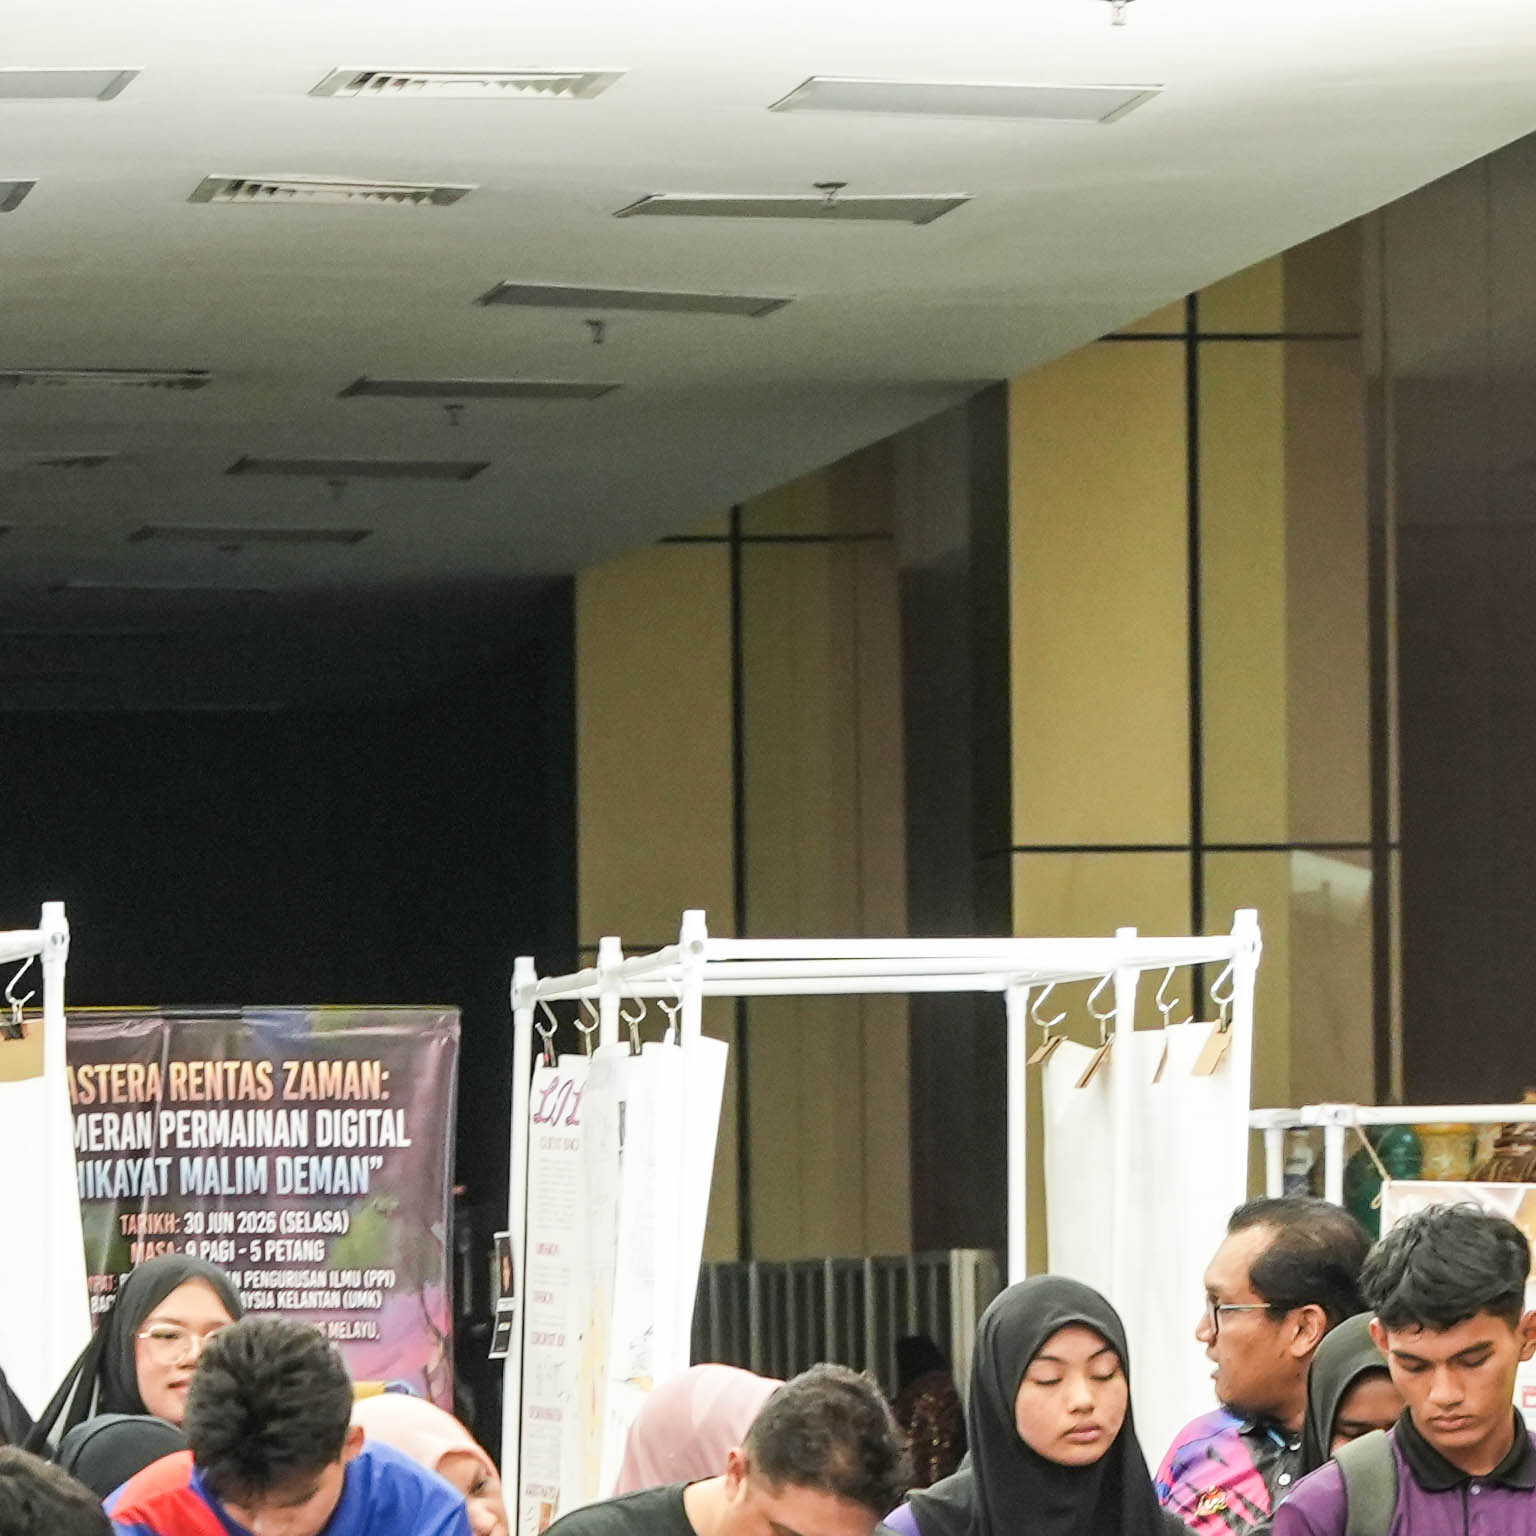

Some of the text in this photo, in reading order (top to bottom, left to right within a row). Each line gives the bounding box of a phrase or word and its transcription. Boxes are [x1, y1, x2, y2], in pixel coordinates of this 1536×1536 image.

[169, 1061, 273, 1101] RENTAS
[282, 1060, 390, 1101] ZAMAN:
[159, 1109, 308, 1149] PERMAINAN
[316, 1109, 412, 1148] DIGITAL
[180, 1156, 268, 1196] MALIM
[119, 1209, 349, 1236] TARIKH: 30 JUN 2026 (SELASA)
[199, 1240, 235, 1262] PAGI
[250, 1240, 262, 1263] 5
[265, 1239, 325, 1263] PETANG
[243, 1269, 327, 1289] PENGURUSAN
[329, 1269, 362, 1288] ILMU
[277, 1290, 341, 1309] KELANTAN
[343, 1290, 383, 1310] (UMK)
